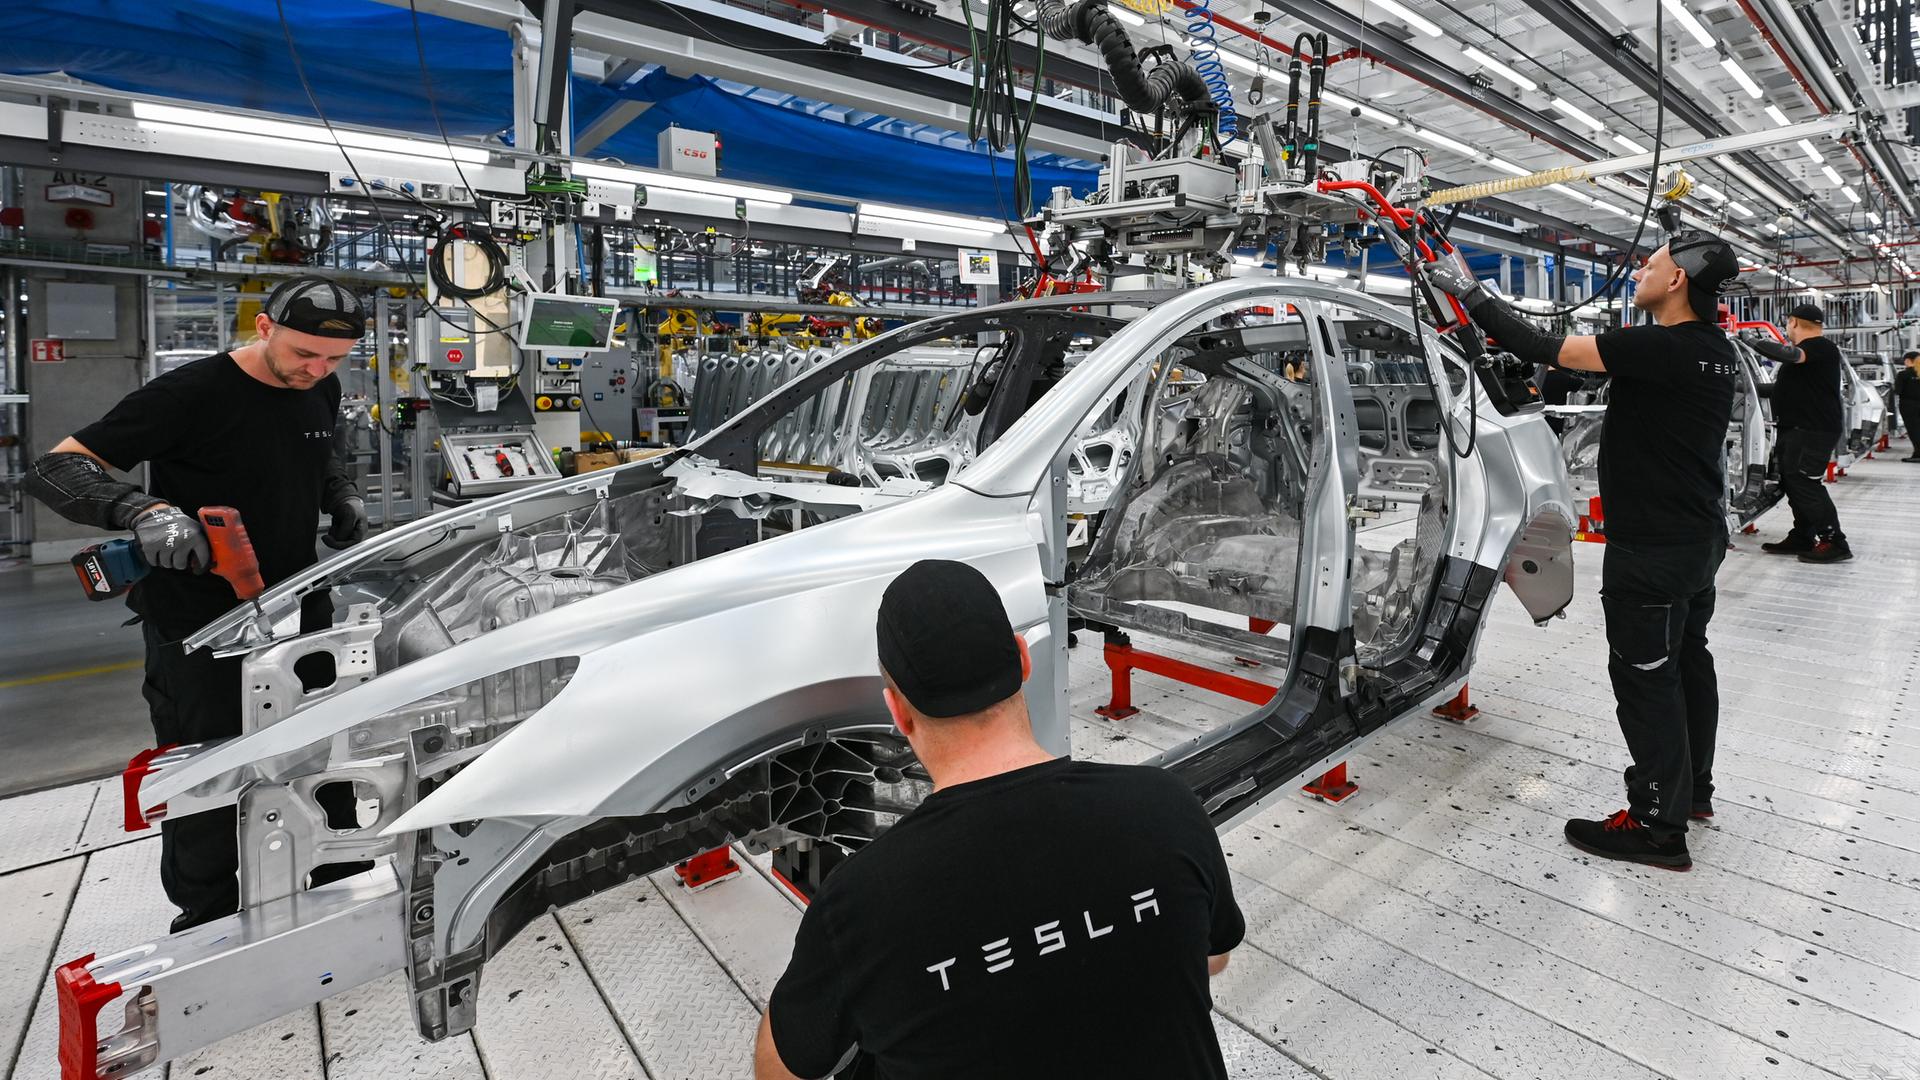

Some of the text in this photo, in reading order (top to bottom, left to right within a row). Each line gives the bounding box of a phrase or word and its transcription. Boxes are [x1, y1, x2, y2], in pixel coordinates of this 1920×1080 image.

[683, 148, 707, 159] CSG
[1698, 361, 1736, 374] TESL
[303, 430, 332, 439] TESL
[926, 888, 1160, 991] TESLA
